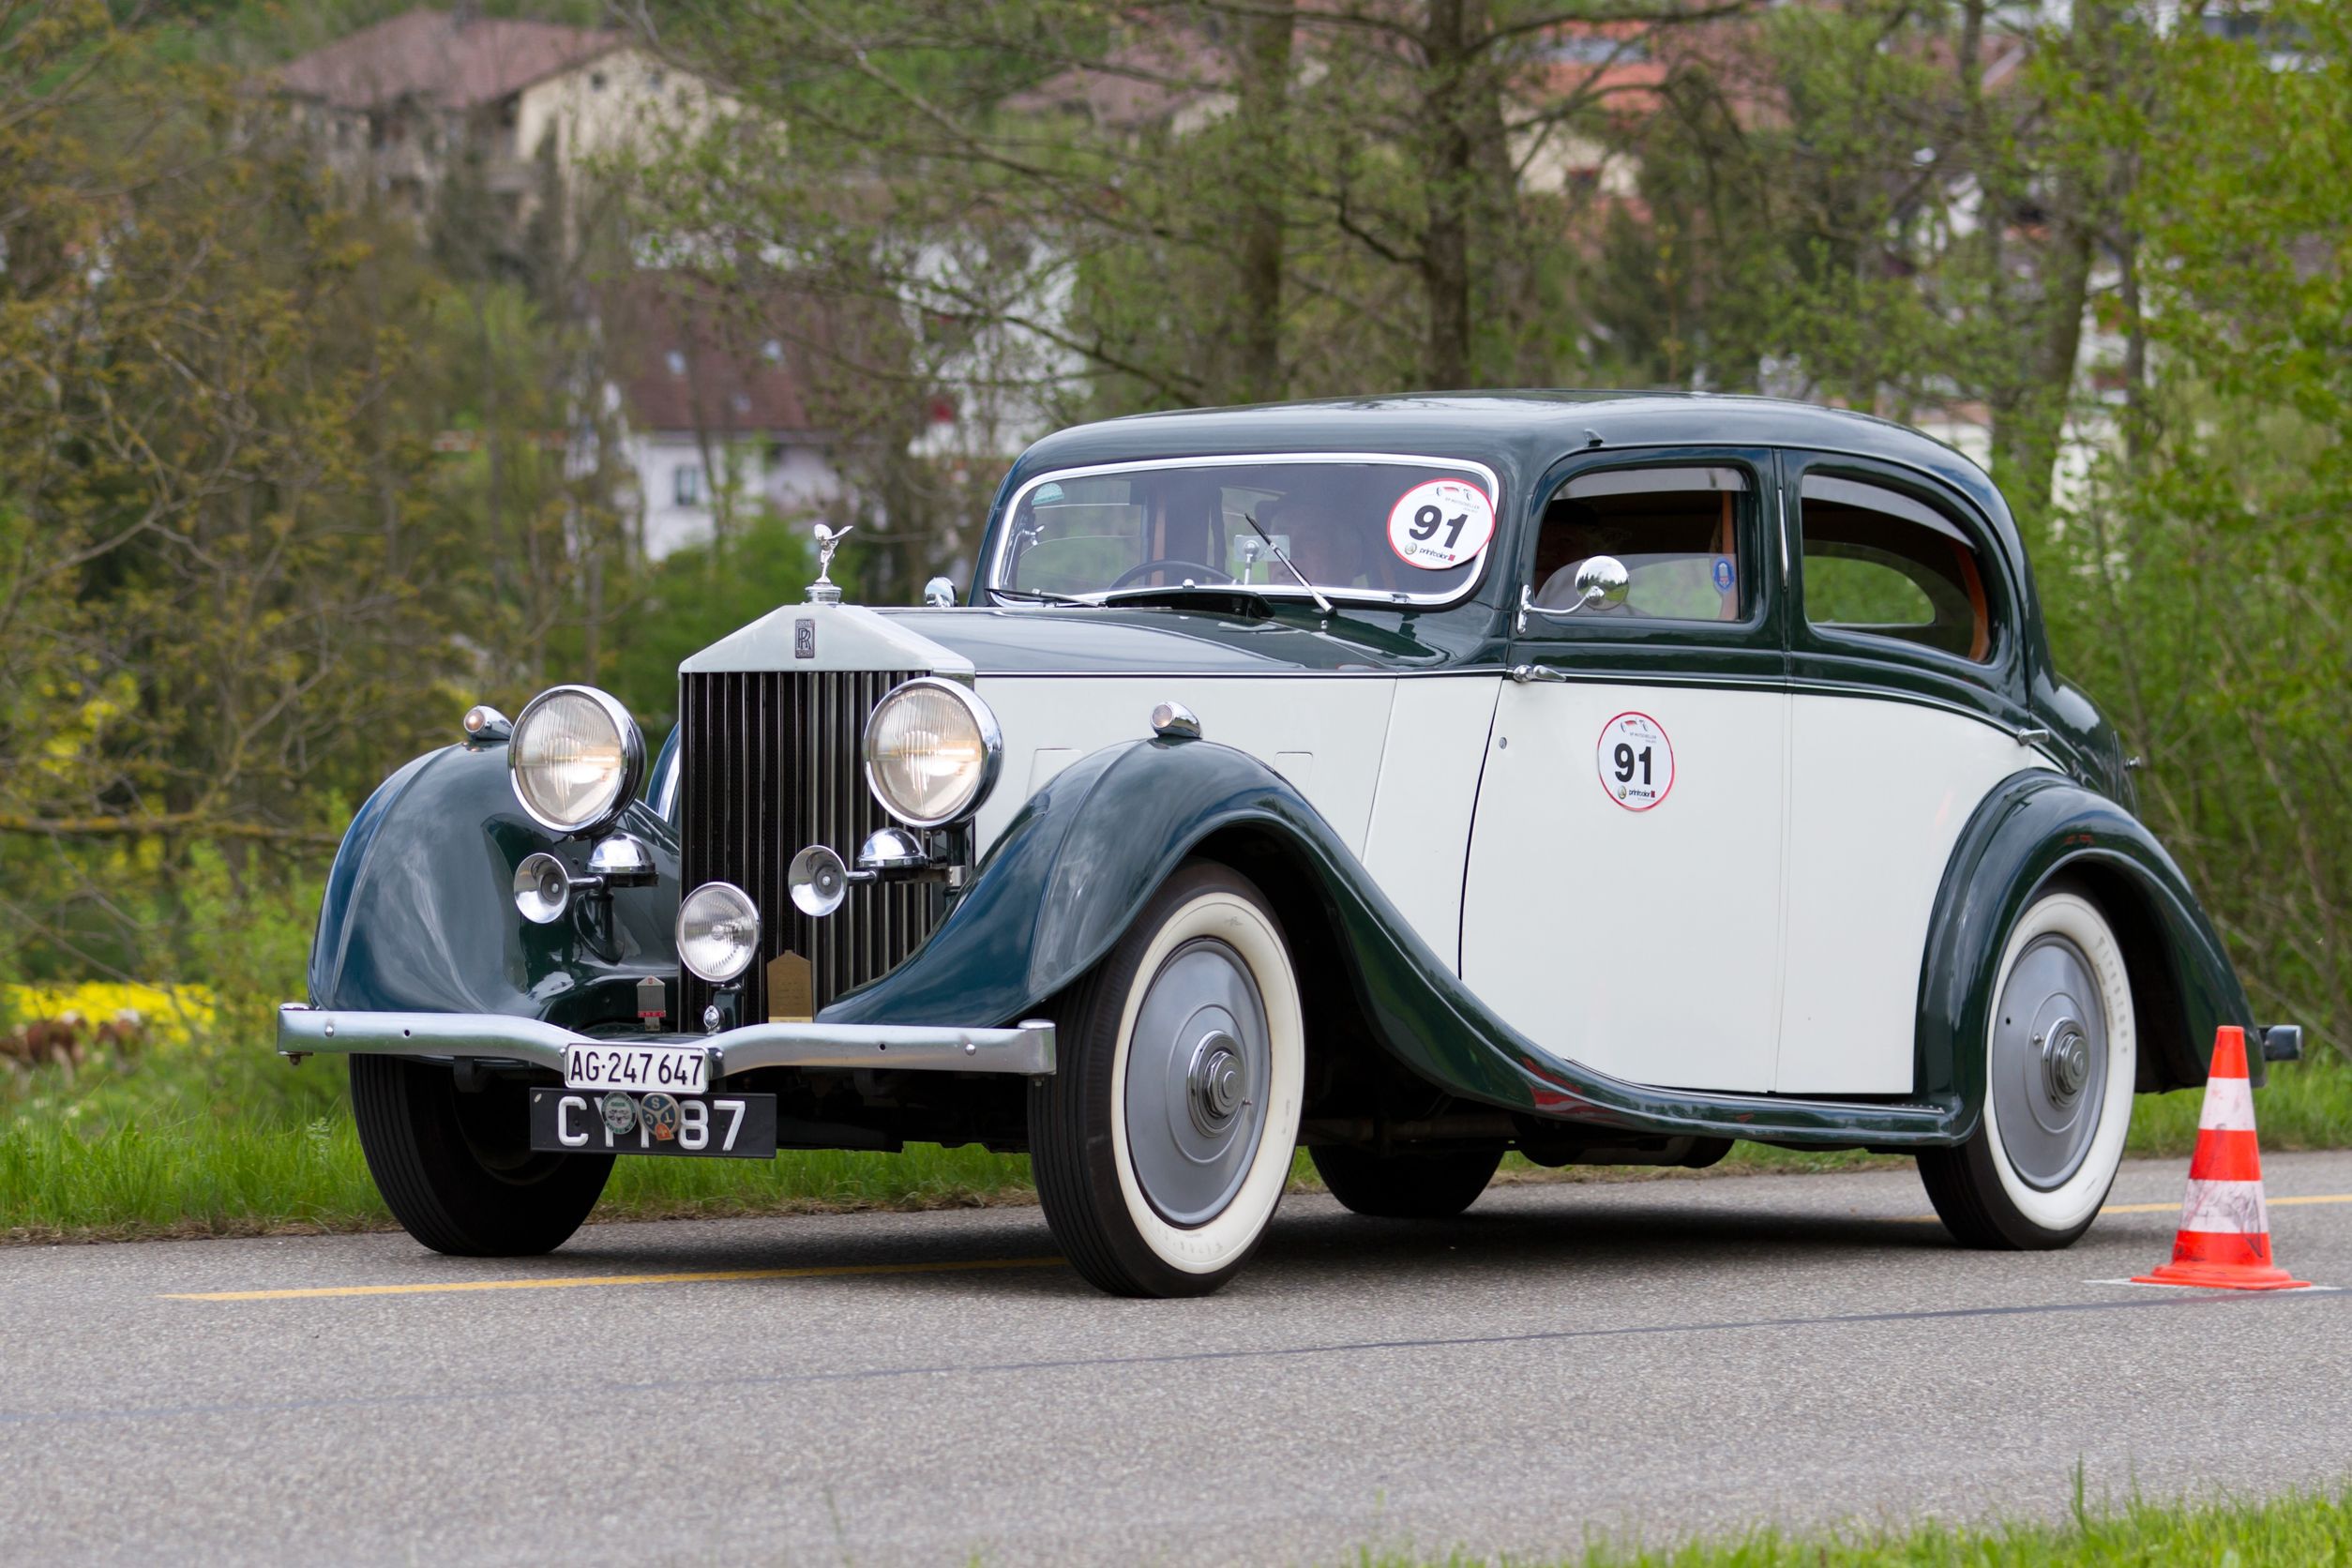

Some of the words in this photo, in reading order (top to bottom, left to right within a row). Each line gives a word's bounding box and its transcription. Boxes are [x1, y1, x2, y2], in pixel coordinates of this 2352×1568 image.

[1409, 505, 1469, 550] 91
[1420, 548, 1449, 560] printcolor
[1614, 743, 1651, 785] 91
